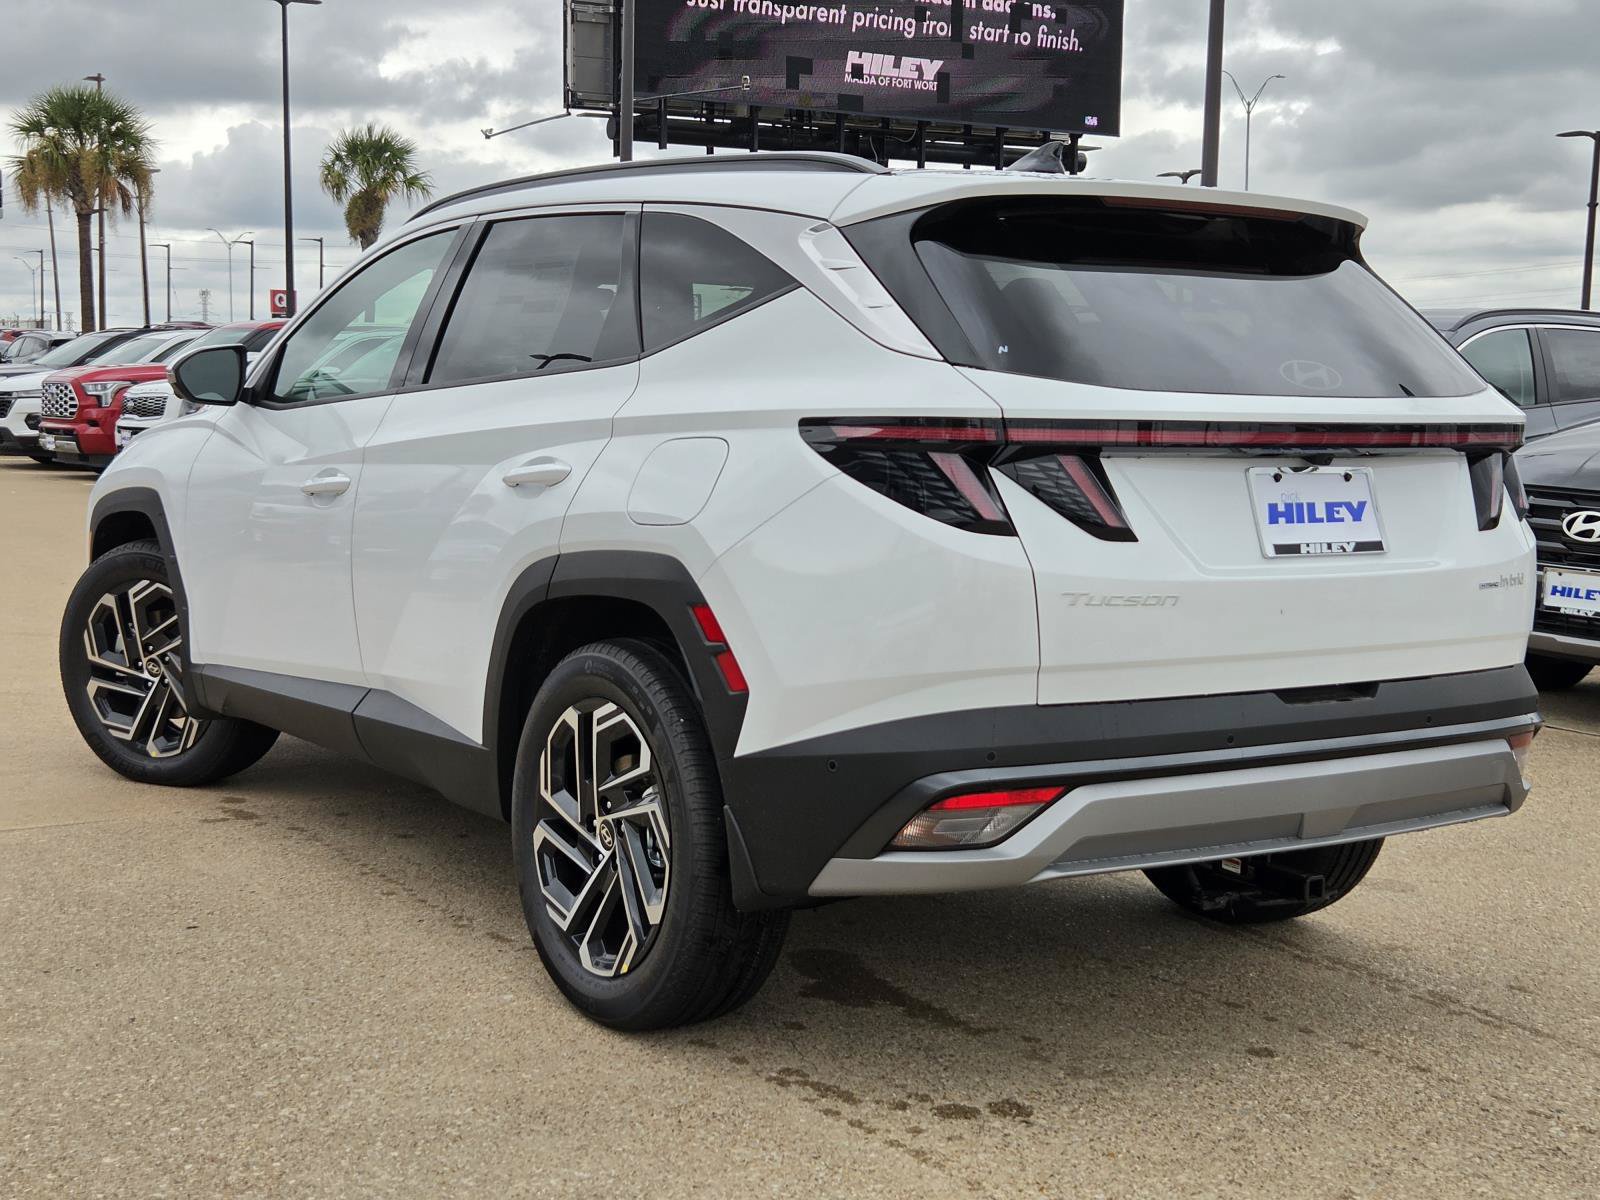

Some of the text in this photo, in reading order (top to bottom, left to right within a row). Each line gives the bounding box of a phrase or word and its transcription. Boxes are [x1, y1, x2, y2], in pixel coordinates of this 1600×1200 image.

[733, 0, 847, 24] transparent
[851, 6, 917, 39] pricing
[923, 10, 952, 36] fro
[969, 21, 1010, 43] start
[1037, 24, 1083, 52] finish.
[845, 50, 944, 80] HILEY
[844, 73, 938, 91] MDA OF FORT WORT
[1267, 500, 1367, 525] HILEY
[1300, 541, 1356, 554] HILEY
[1550, 584, 1600, 601] HILE
